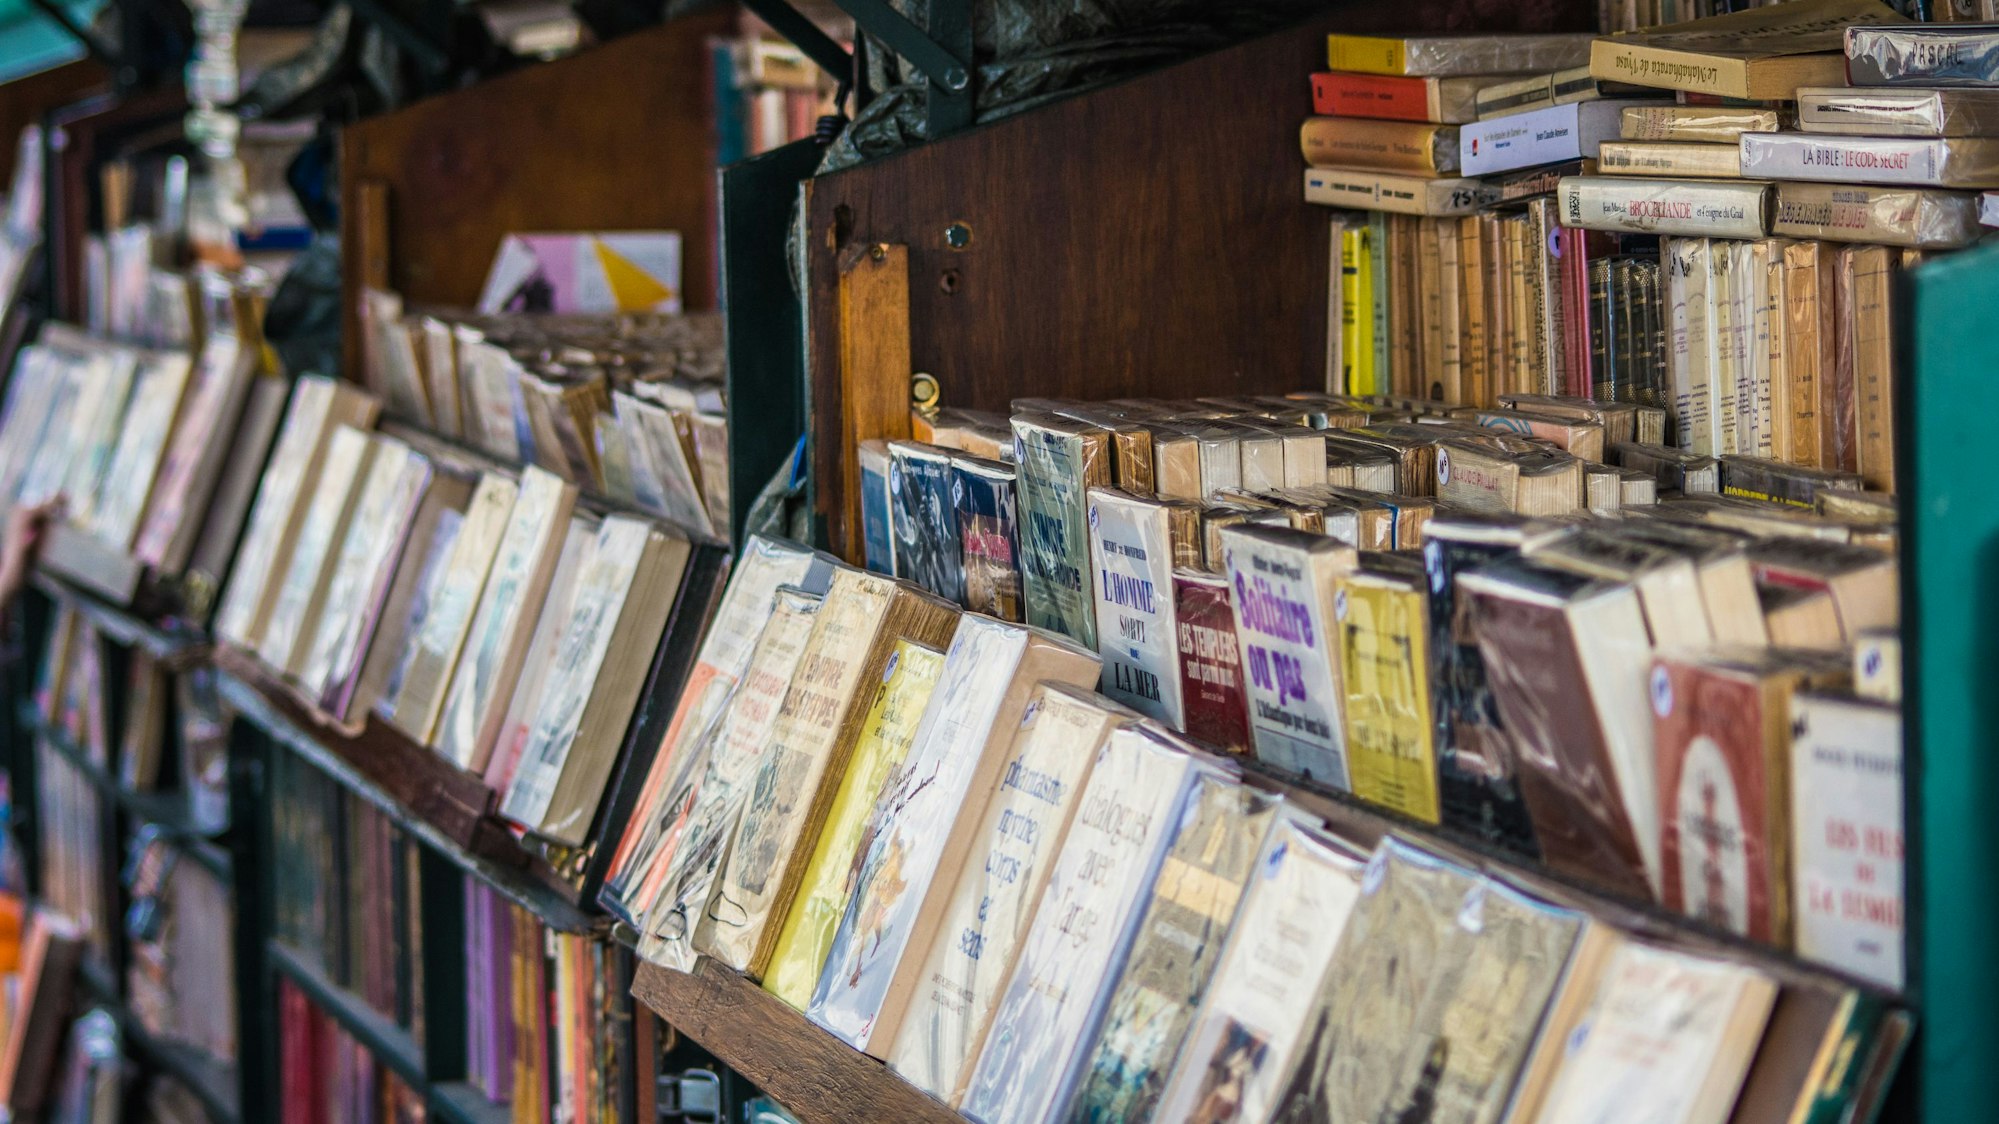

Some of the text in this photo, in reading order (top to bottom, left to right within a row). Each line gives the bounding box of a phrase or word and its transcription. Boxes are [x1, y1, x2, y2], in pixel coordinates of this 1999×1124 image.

[1640, 59, 1649, 78] de
[1912, 41, 1961, 65] PASCAL
[1651, 60, 1707, 84] Mahabharata
[1707, 67, 1718, 85] Le
[1803, 149, 1814, 165] LA
[1845, 151, 1853, 167] LE
[1855, 151, 1878, 168] CODE
[1880, 152, 1910, 169] SECRET
[1102, 569, 1156, 614] L'HOMME
[1235, 569, 1314, 649] Solitaire
[1119, 614, 1146, 644] SORTI
[1178, 621, 1239, 666] LES TEMPLIERS
[1114, 661, 1161, 704] LA MER
[1187, 658, 1201, 681] sont
[1200, 661, 1220, 685] parmi
[1247, 644, 1306, 707] ou pas
[998, 808, 1038, 845] mythe
[1082, 789, 1152, 847] dialogues
[985, 849, 1021, 888] corps
[1078, 849, 1115, 887] avec
[957, 927, 987, 961] sens
